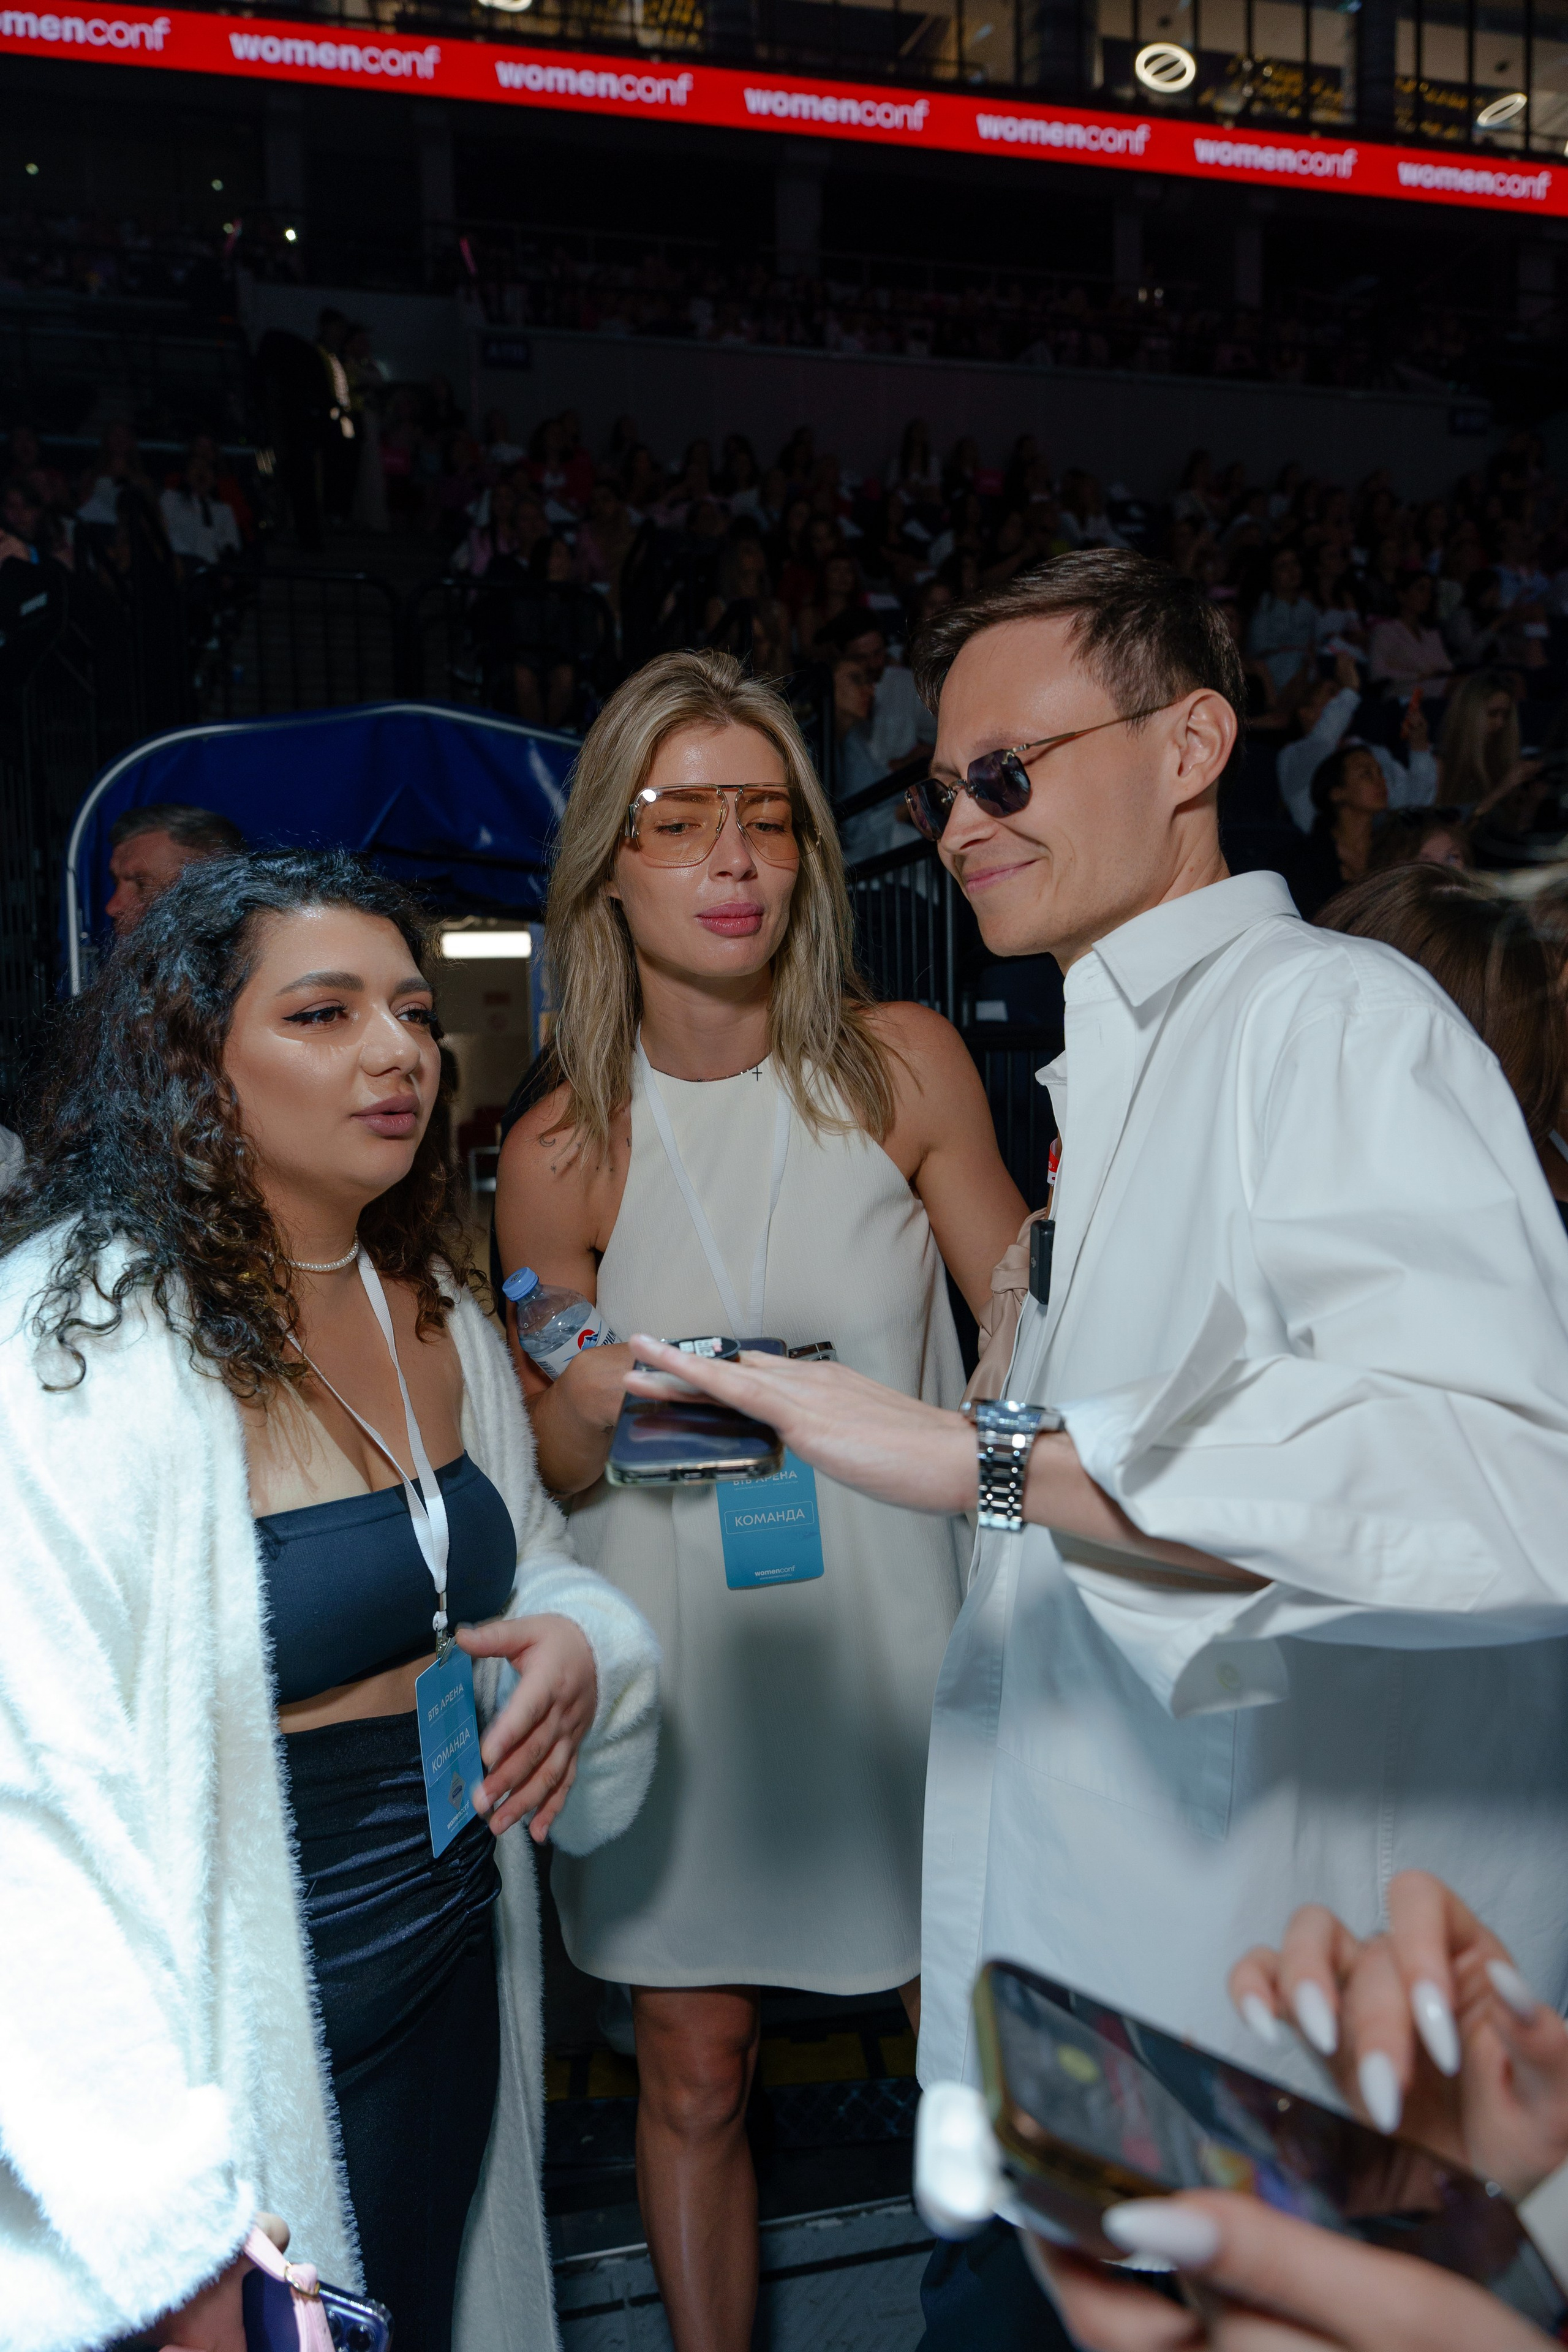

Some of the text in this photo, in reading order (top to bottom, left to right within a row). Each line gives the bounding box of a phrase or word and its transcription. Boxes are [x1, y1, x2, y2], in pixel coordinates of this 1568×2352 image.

[0, 9, 1552, 200] menconf womenconf womenconf womenconf womenconf womenconf womenconf
[734, 1508, 805, 1527] КОМАНДА
[753, 1564, 796, 1577] womenconf
[428, 1703, 439, 1722] ВТБ
[440, 1683, 464, 1711] АРЕНА
[431, 1727, 470, 1774] КОМАНДА
